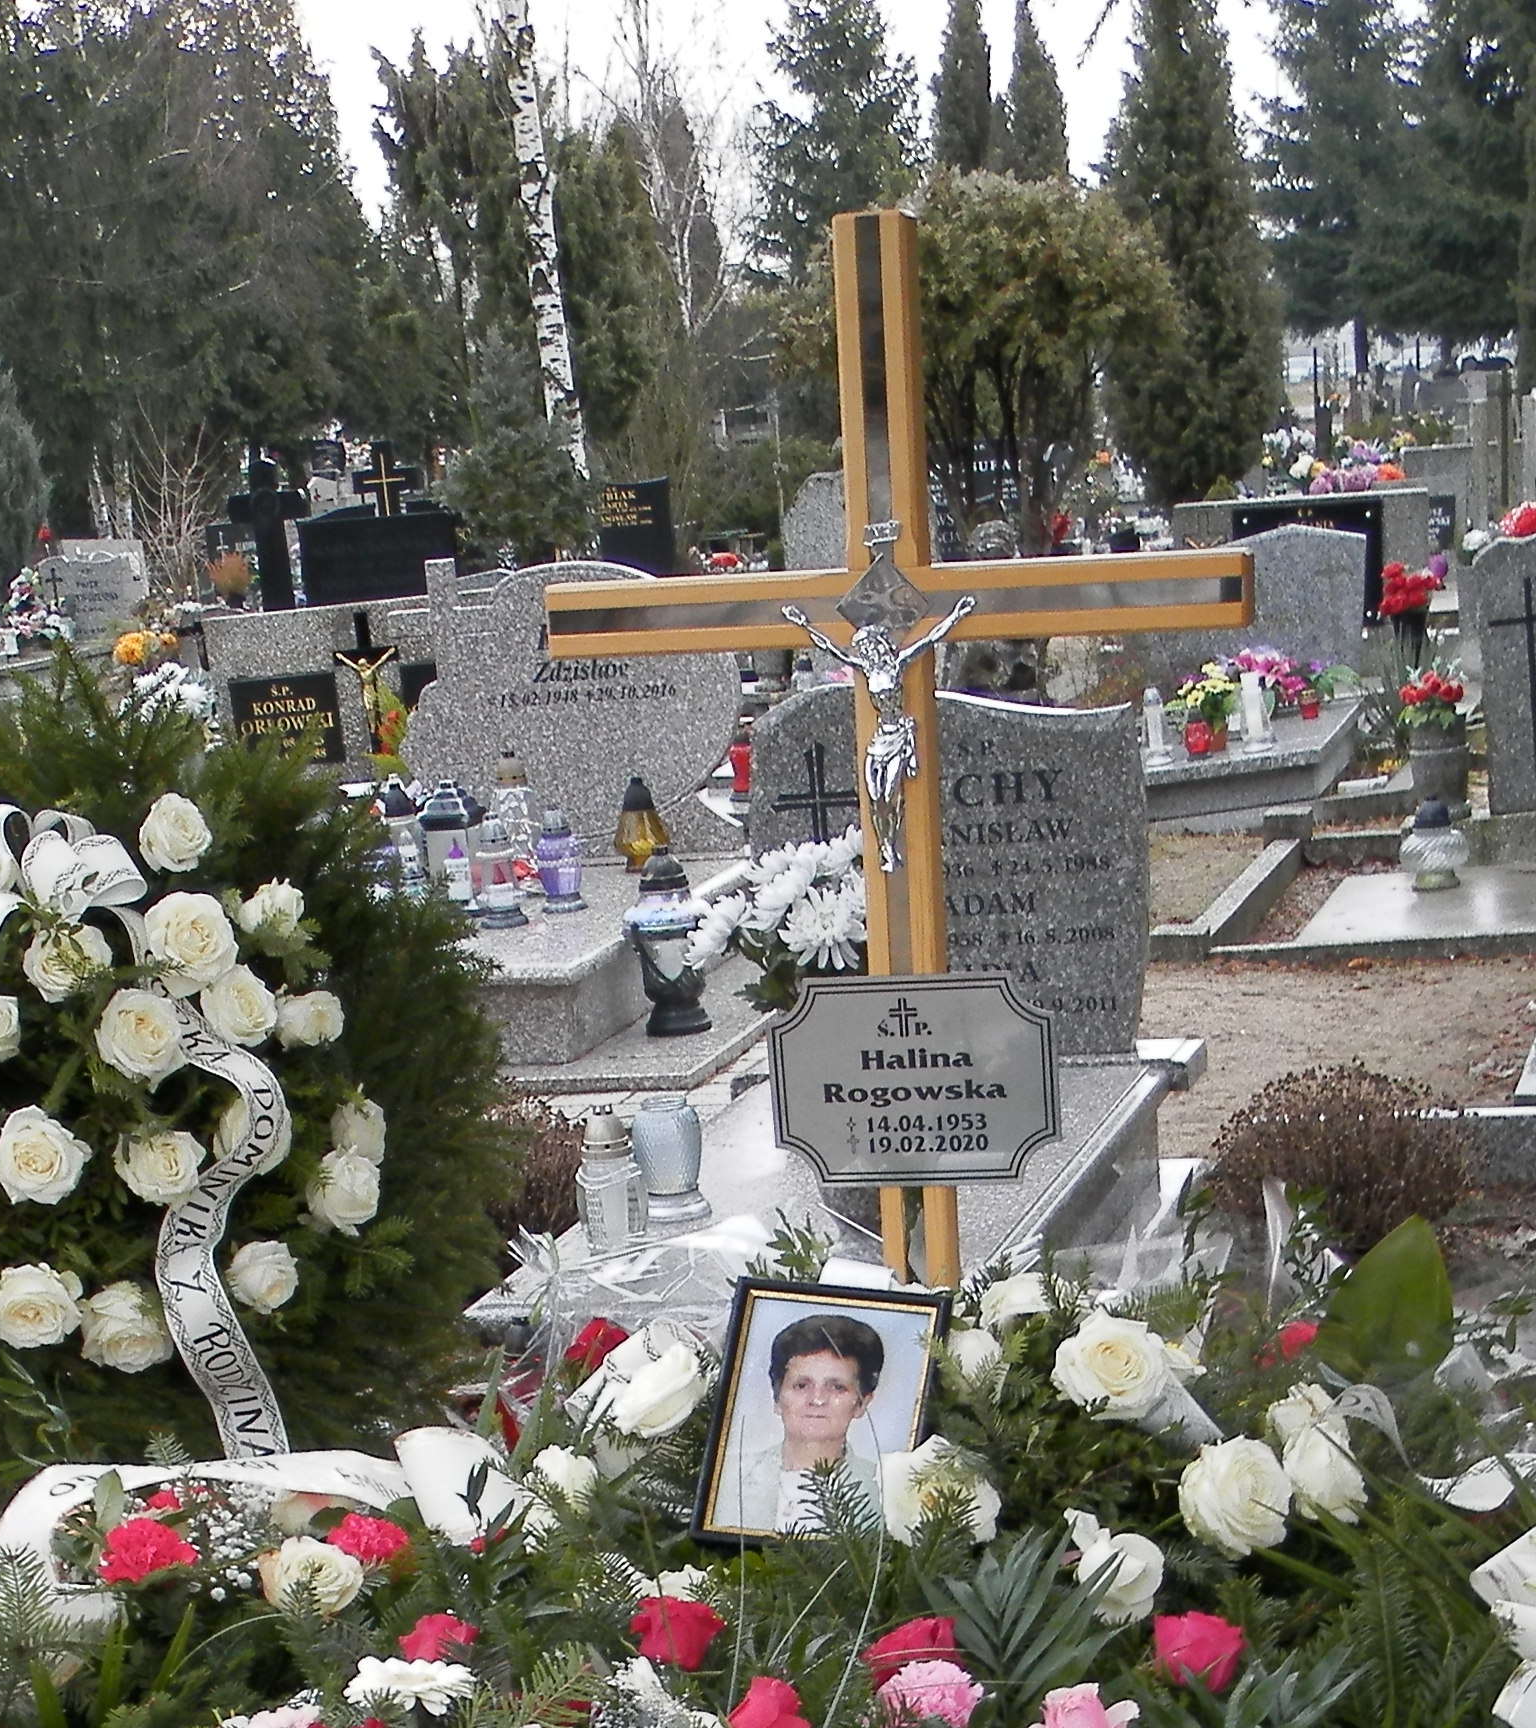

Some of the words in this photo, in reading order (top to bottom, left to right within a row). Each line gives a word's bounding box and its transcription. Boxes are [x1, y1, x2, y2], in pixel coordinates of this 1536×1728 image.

[252, 697, 317, 717] KONRAD
[860, 1048, 974, 1071] Halina
[822, 1079, 1008, 1109] Rogowska
[866, 1113, 988, 1134] 14.04.1953
[868, 1133, 990, 1154] 19.02.2020
[173, 1077, 278, 1261] DOMINIKA
